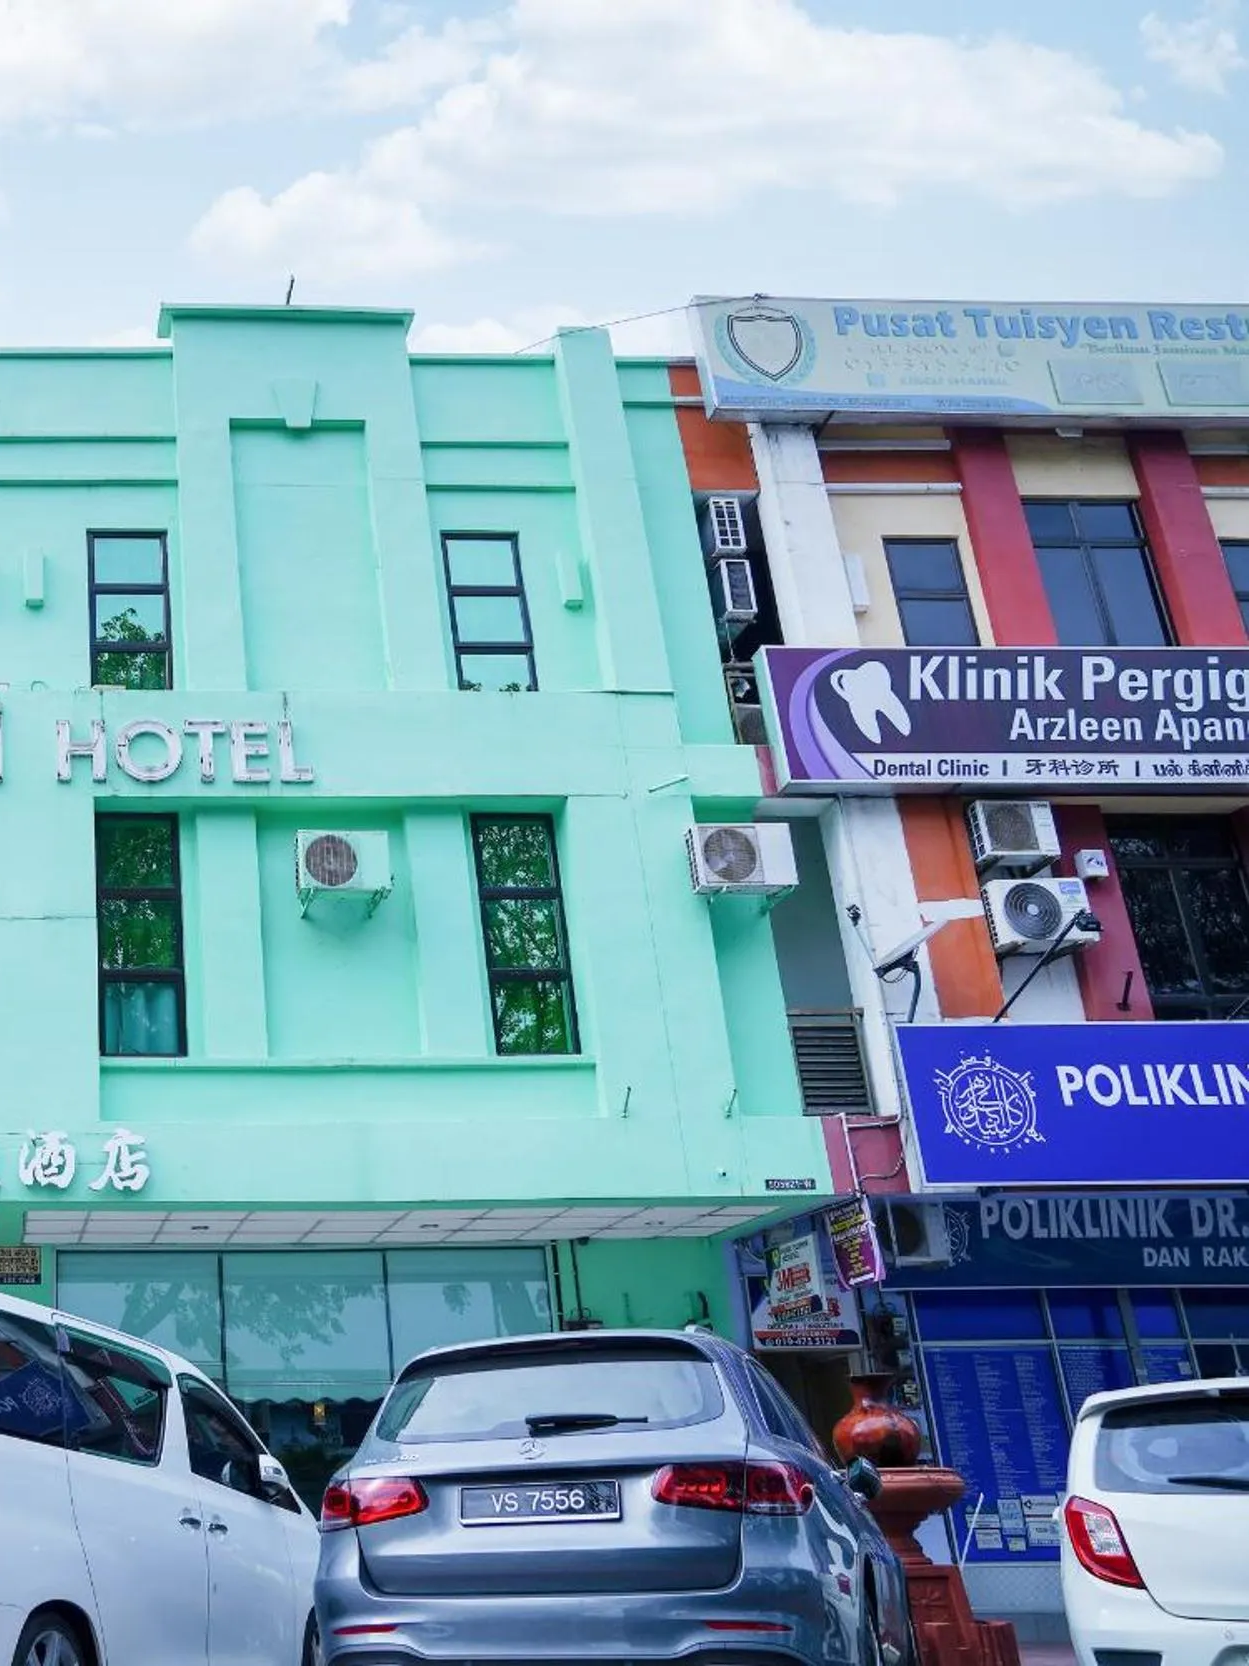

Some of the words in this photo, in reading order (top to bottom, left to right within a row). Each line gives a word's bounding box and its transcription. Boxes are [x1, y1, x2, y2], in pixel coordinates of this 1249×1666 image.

[833, 306, 955, 338] Pusat
[963, 308, 1139, 348] Tuisyen
[1148, 310, 1249, 341] Rest
[910, 655, 1065, 700] Klinik
[1083, 656, 1249, 711] Pergig
[1009, 708, 1142, 741] Arzleen
[1155, 708, 1249, 750] Apan
[55, 716, 314, 784] HOTEL
[873, 758, 932, 777] Dental
[937, 758, 989, 777] Clinic
[1025, 759, 1119, 775] 牙科诊所
[979, 1198, 1174, 1239] POLIKLINIK
[1143, 1246, 1190, 1267] DAN
[490, 1493, 518, 1512] VS
[526, 1490, 585, 1511] 7556
